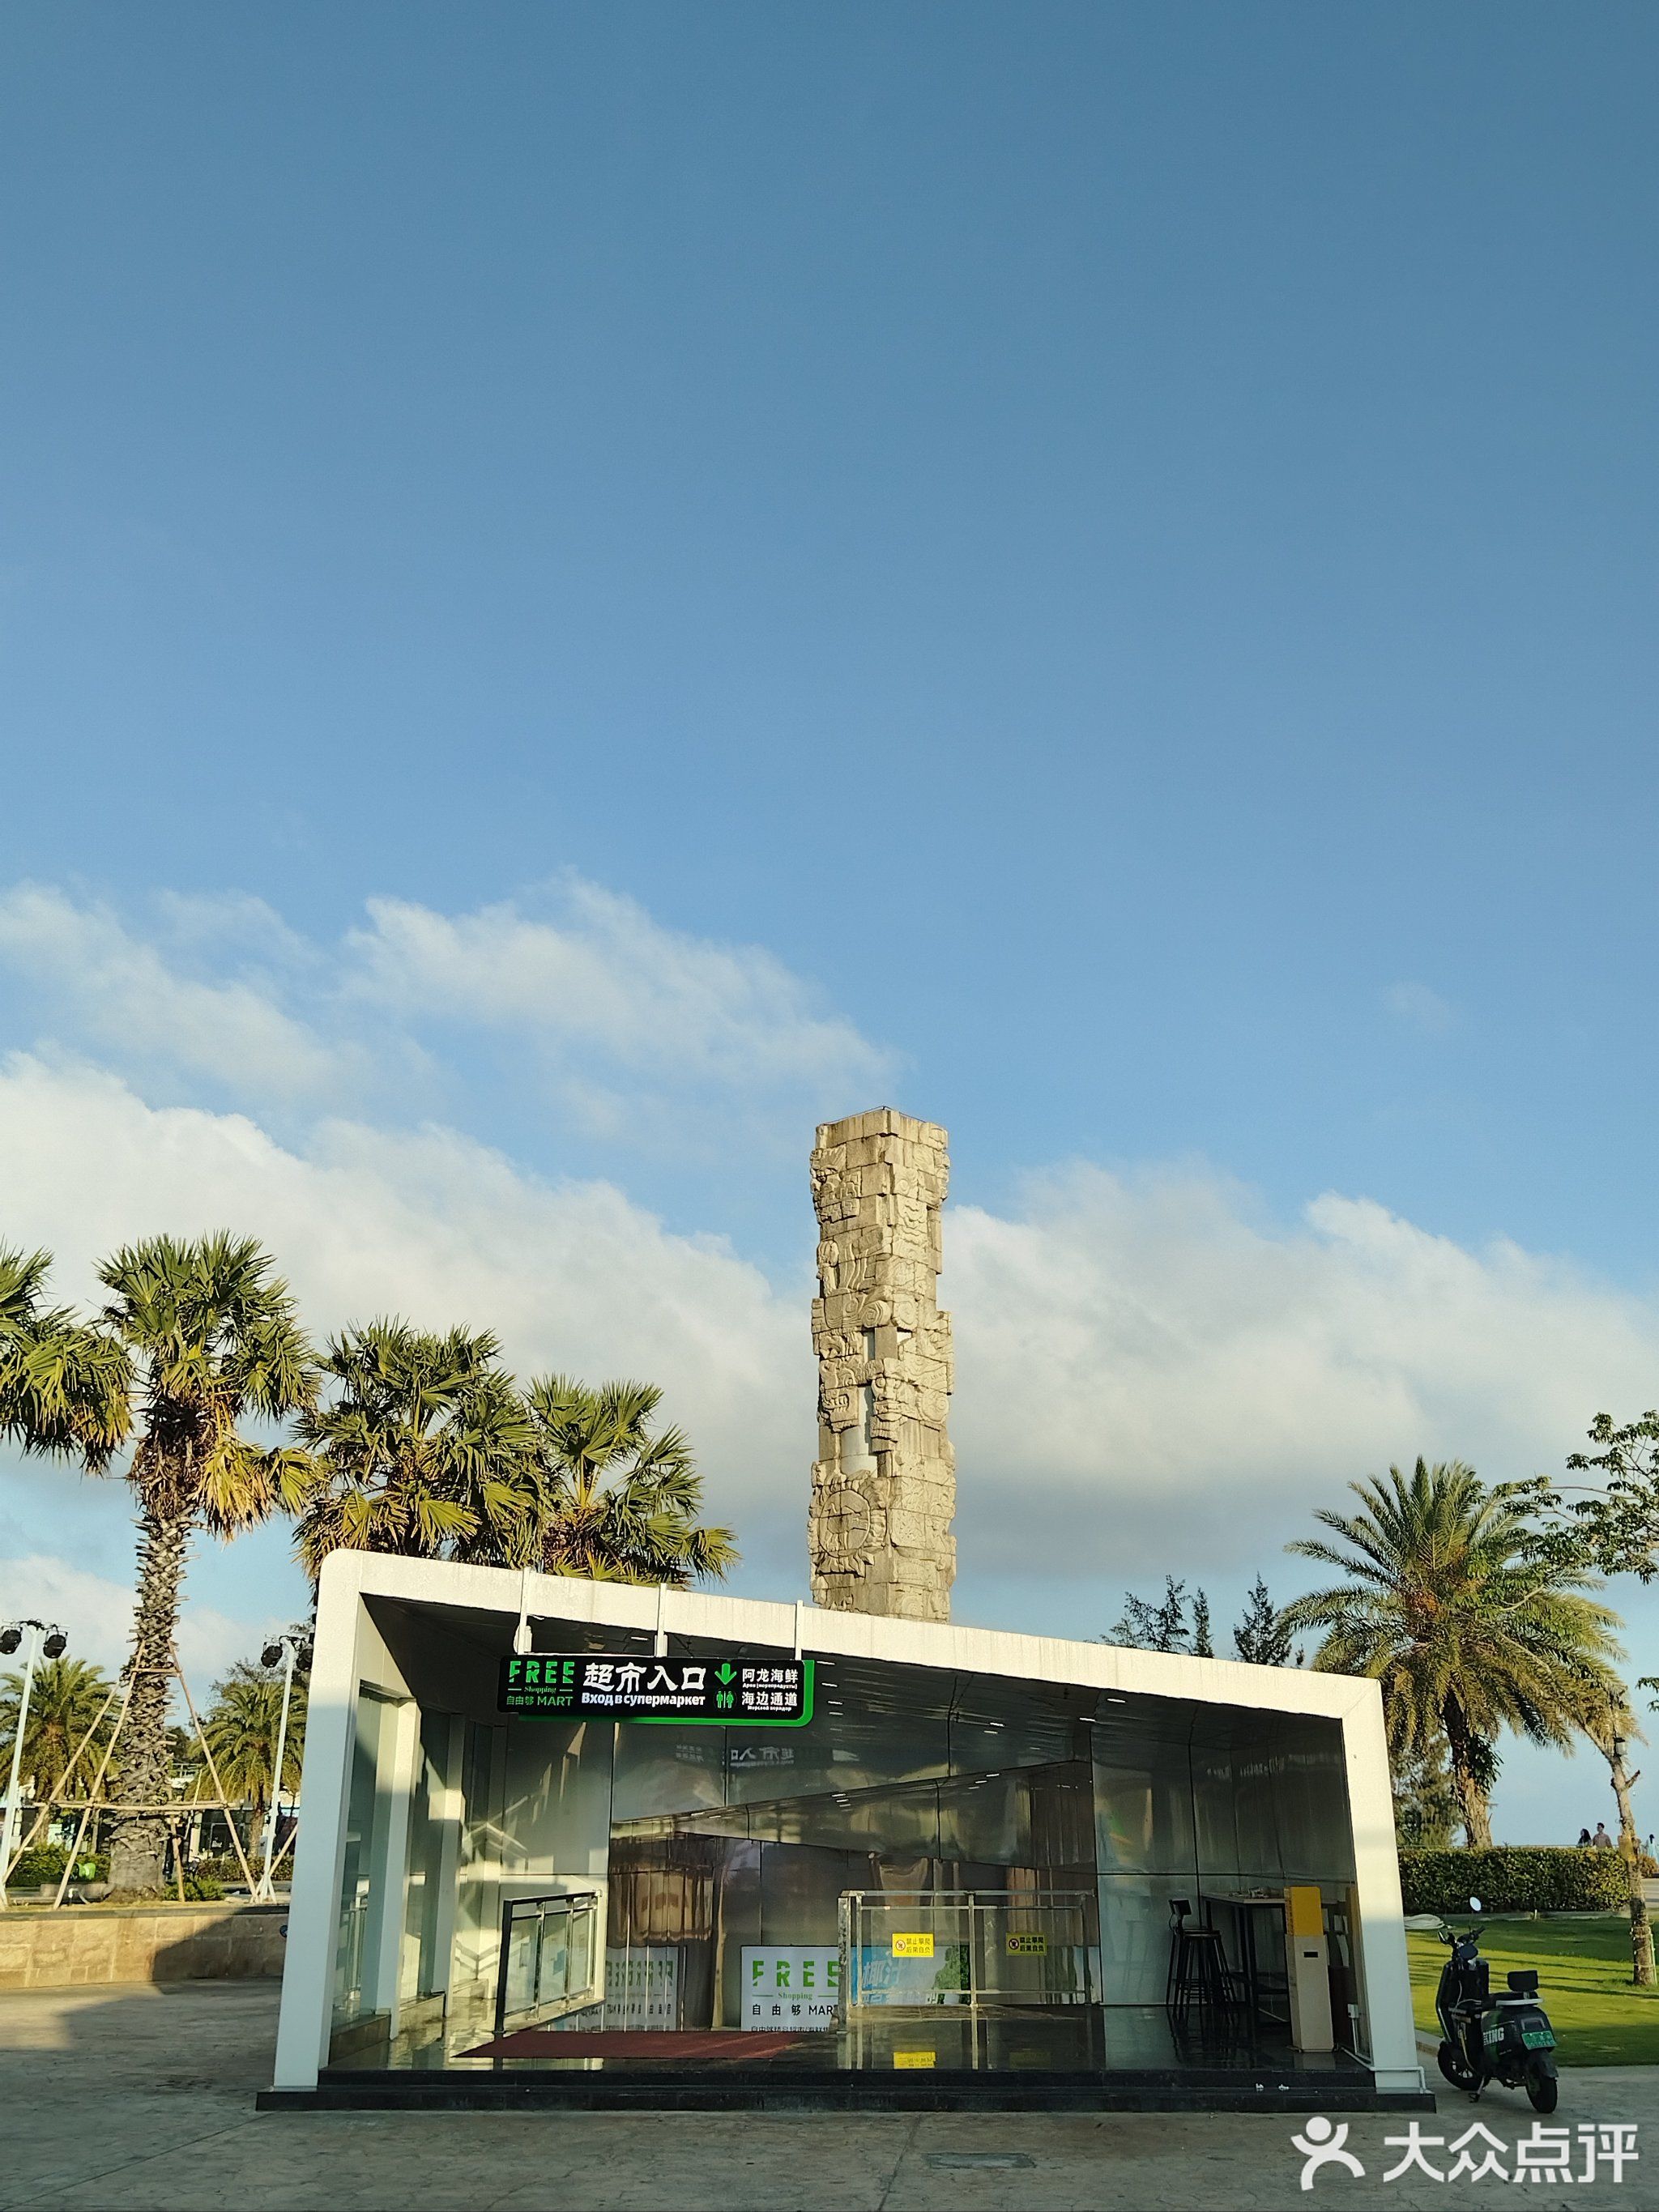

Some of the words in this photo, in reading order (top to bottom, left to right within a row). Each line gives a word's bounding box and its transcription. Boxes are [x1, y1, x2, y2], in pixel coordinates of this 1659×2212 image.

[509, 1660, 575, 1684] FREE
[582, 1662, 706, 1694] 超市入口
[742, 1668, 799, 1683] 阿龙海鲜
[523, 1686, 557, 1694] Shopping
[506, 1695, 535, 1706] 自由够
[537, 1695, 574, 1707] MART
[582, 1692, 613, 1706] Вход
[624, 1694, 706, 1708] супермаркет
[741, 1690, 798, 1707] 海边通道
[752, 1960, 839, 1988] FREE
[777, 1993, 813, 2001] Shopping
[752, 2004, 802, 2016] 自由够
